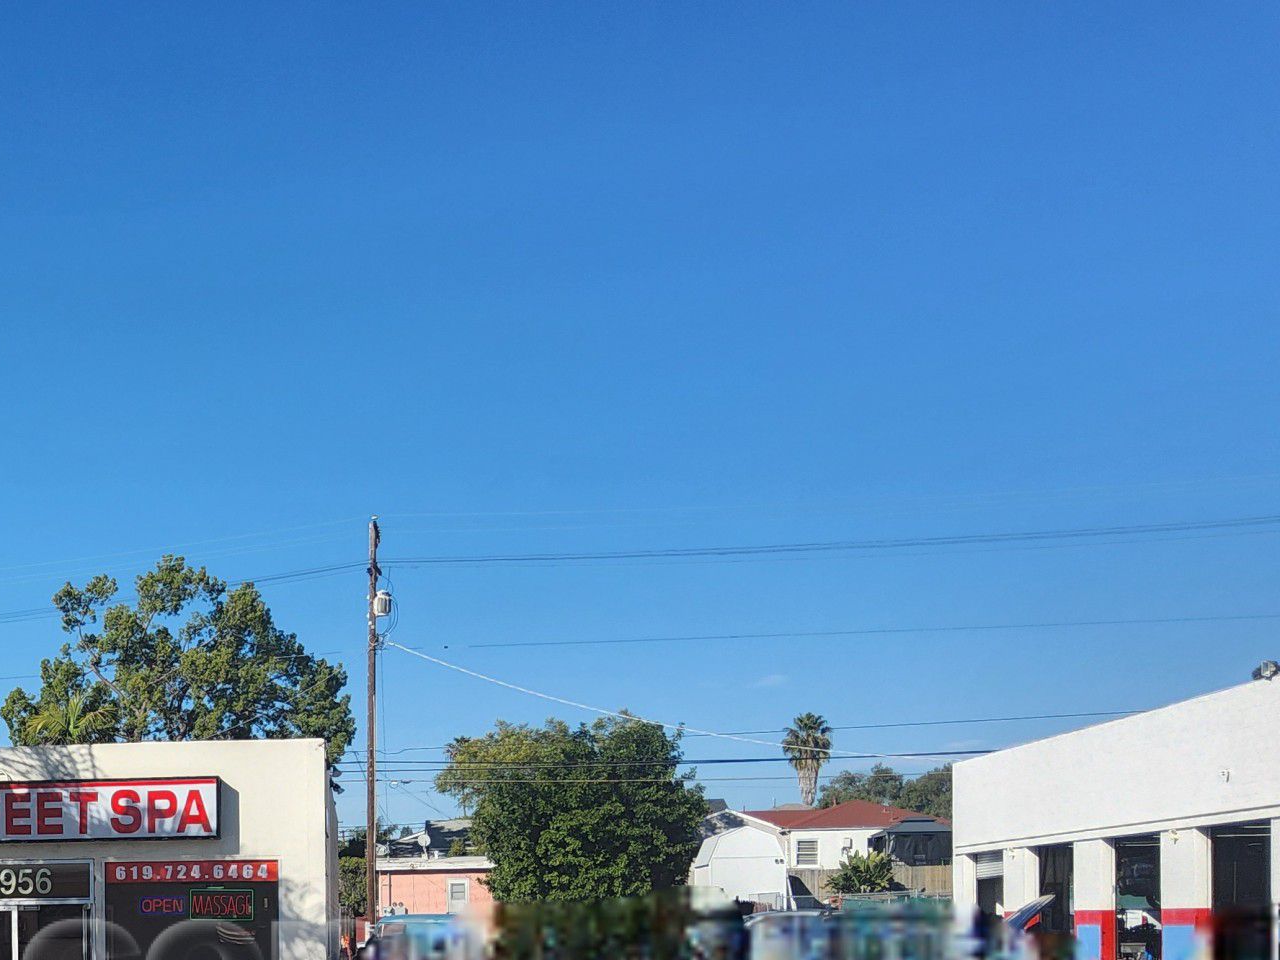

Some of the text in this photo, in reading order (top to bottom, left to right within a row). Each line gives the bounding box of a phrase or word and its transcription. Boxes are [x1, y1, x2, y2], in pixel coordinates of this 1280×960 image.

[110, 788, 214, 834] SPA
[115, 864, 269, 881] 619.724.6464
[141, 898, 184, 914] OPEN
[191, 894, 252, 916] MASSAGE
